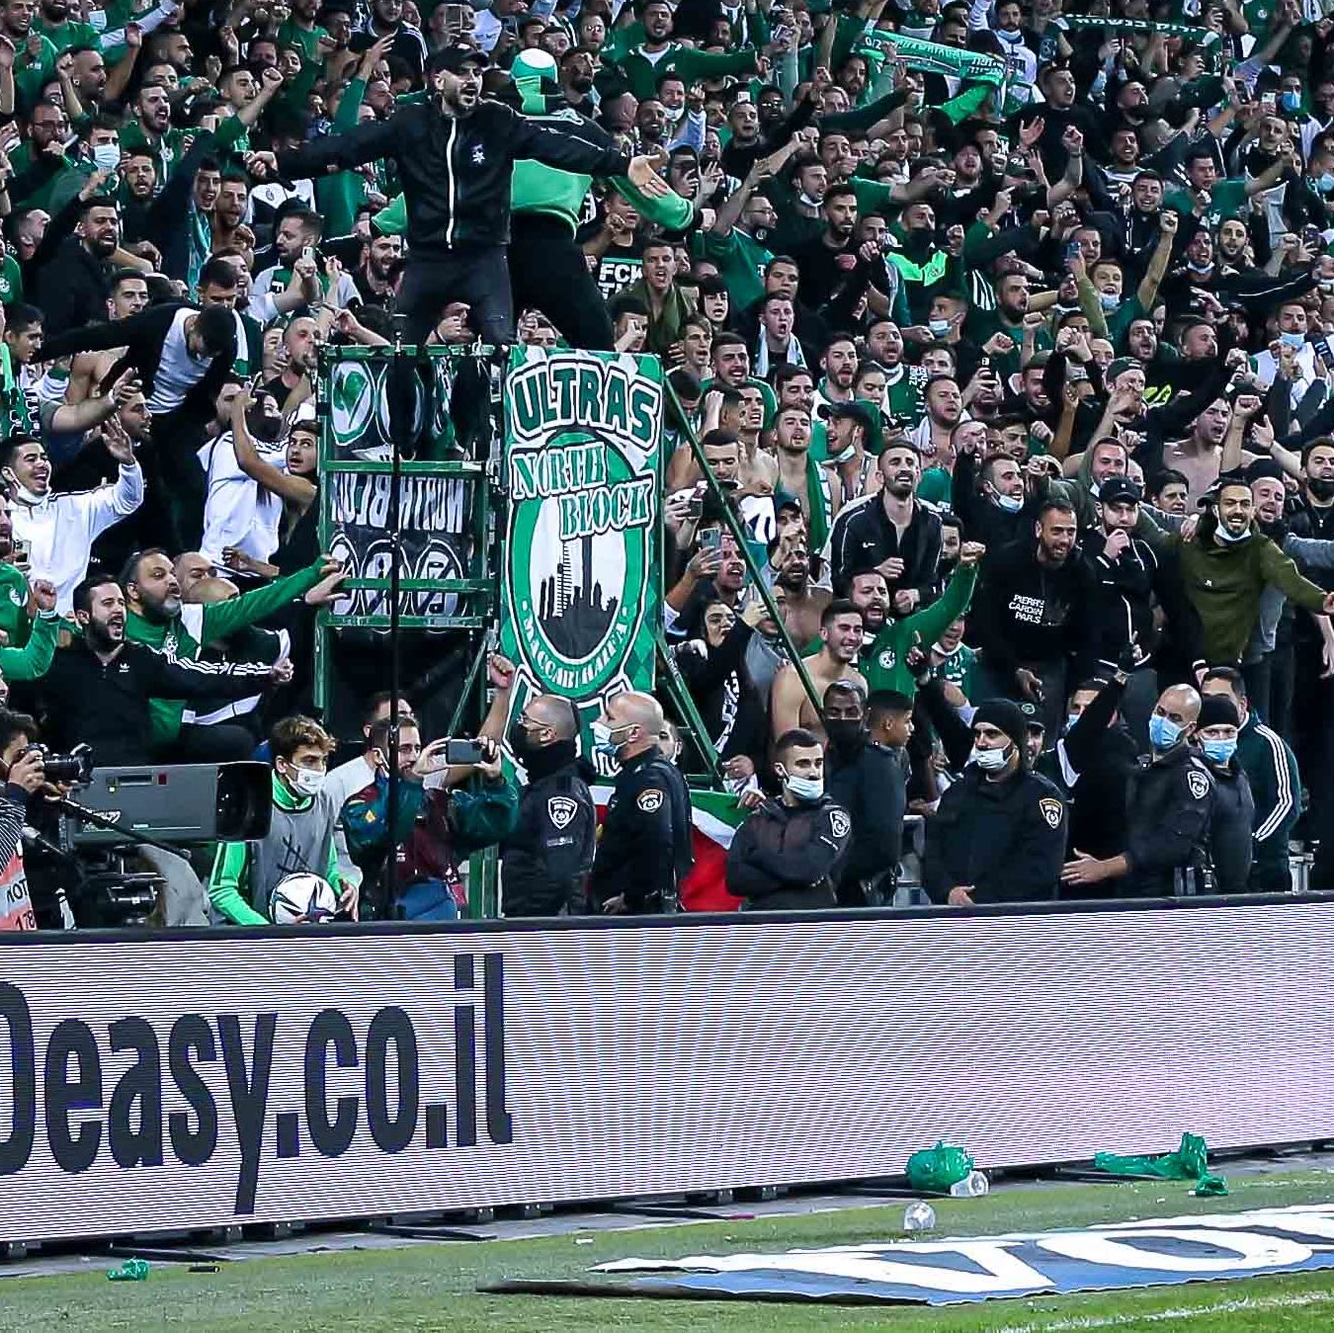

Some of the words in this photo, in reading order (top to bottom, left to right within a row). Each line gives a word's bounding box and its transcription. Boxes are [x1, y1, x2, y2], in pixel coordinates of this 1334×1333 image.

[510, 361, 659, 449] ULTRAS
[511, 441, 605, 501] NORTH
[557, 478, 654, 542] BLOCK
[522, 614, 579, 688] MACCABI
[581, 622, 629, 685] HAIFA
